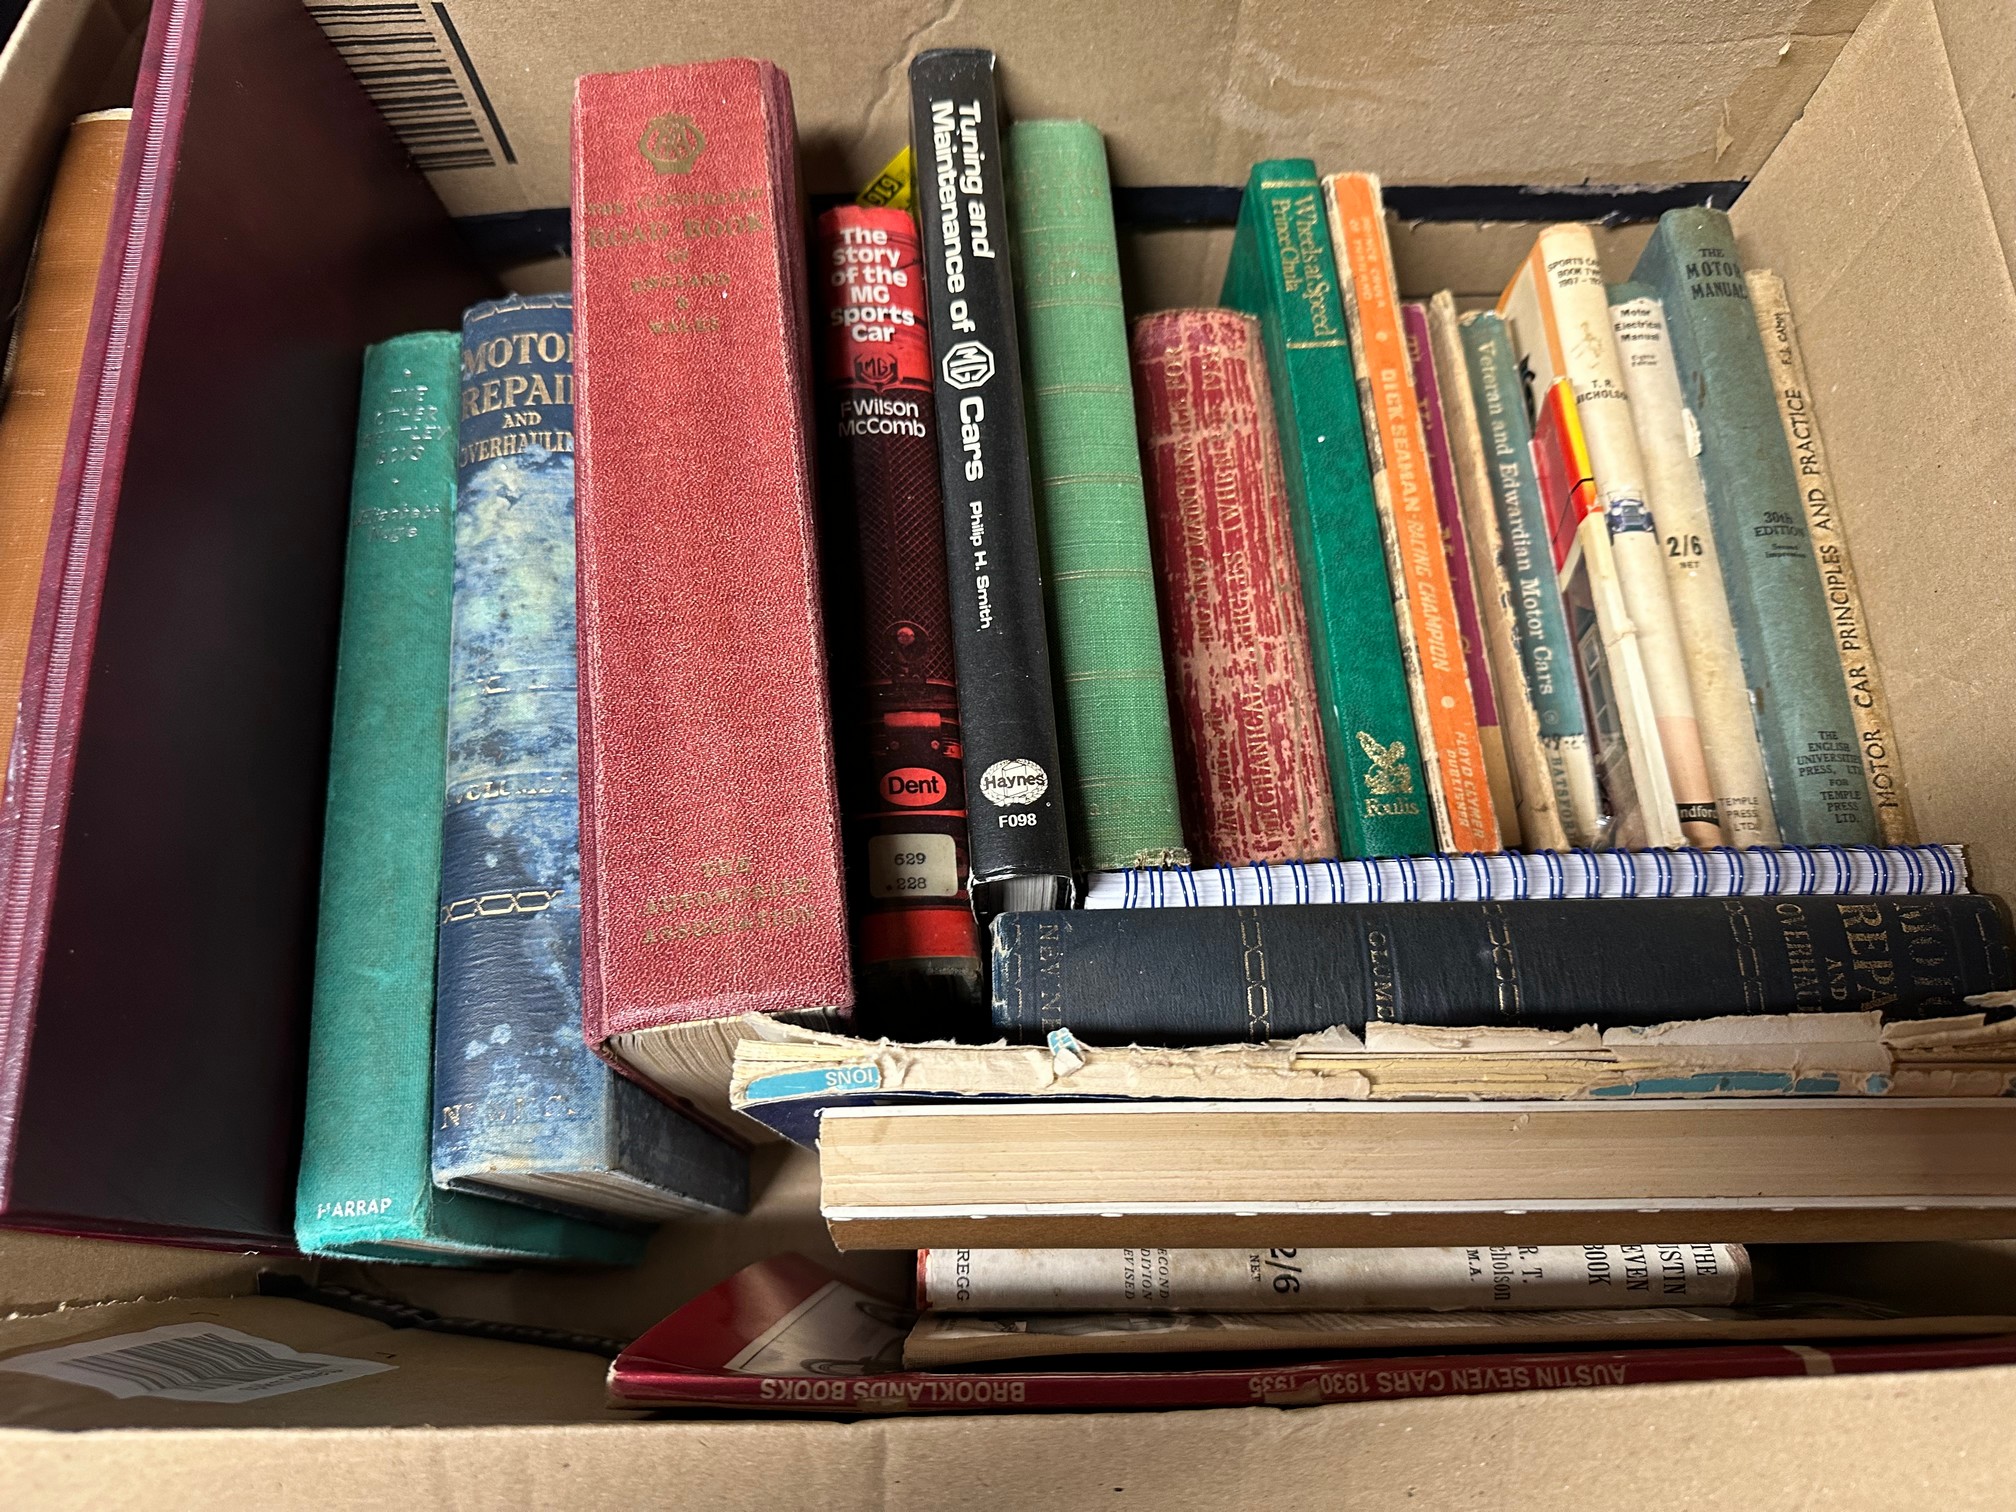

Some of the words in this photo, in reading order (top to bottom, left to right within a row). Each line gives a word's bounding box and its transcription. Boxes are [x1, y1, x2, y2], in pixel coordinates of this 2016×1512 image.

[959, 100, 985, 194] Tuning
[931, 100, 965, 293] Maintenance
[588, 221, 670, 249] ROAD
[684, 212, 765, 239] BOOK
[840, 227, 888, 245] The
[967, 201, 995, 258] and
[1295, 194, 1324, 263] Wheels
[832, 247, 901, 268] story
[1701, 249, 1725, 258] THE
[831, 266, 859, 287] of
[863, 265, 908, 288] the
[1304, 264, 1322, 283] at
[1686, 262, 1742, 280] MOTOR
[630, 272, 731, 294] ENGLAND
[851, 285, 890, 304] MG
[1692, 282, 1748, 300] MANUAL
[830, 304, 915, 327] sports
[950, 300, 976, 333] of
[1302, 281, 1337, 338] Speed
[1620, 308, 1651, 318] Motor
[649, 318, 720, 336] WALES
[851, 323, 895, 343] Car
[1614, 321, 1662, 332] Electrical
[1620, 332, 1661, 342] Manual
[865, 357, 889, 377] MG
[947, 343, 991, 387] MG
[1478, 340, 1504, 416] Veteran
[462, 374, 573, 421] REPAI
[1381, 369, 1404, 420] DICK
[854, 398, 919, 418] Wilson
[502, 411, 542, 429] AND
[838, 417, 926, 438] McComb
[960, 396, 985, 482] Cars
[1491, 420, 1515, 457] and
[1785, 389, 1820, 475] PRACTICE
[1391, 424, 1420, 512] SEAMAN
[1499, 462, 1533, 572] Edwardian
[1764, 511, 1793, 525] 30th
[1808, 488, 1833, 531] AND
[969, 500, 985, 547] Philip
[1754, 525, 1806, 538] EDITION
[1406, 520, 1432, 577] RACING
[1667, 534, 1703, 557] 2/6
[974, 550, 988, 571] H.
[1679, 561, 1701, 569] NET
[976, 575, 993, 629] Smith
[1519, 578, 1546, 640] Motor
[1820, 544, 1861, 651] PRINCIPLES
[1418, 581, 1450, 672] CHAMPION
[1533, 646, 1555, 695] Cars
[1850, 666, 1873, 709] CAR
[1818, 731, 1838, 740] THE
[1456, 731, 1473, 777] FLOYD
[1808, 743, 1850, 752] ENGLISH
[1864, 728, 1898, 809] MOTOR
[888, 776, 939, 795] Dent
[985, 773, 1045, 790] Haynes
[1718, 797, 1759, 806] TEMPLE
[1820, 791, 1861, 800] TEMPLE
[1827, 802, 1858, 812] PRESS
[1363, 797, 1421, 819] Foulis
[1727, 809, 1759, 819] PRESS
[999, 813, 1037, 828] F098
[894, 852, 926, 866] 629
[1836, 903, 1899, 1012] REPA
[1825, 957, 1848, 1000] AND
[825, 1067, 876, 1087] IONS
[957, 1248, 970, 1302] REGG
[1123, 1248, 1136, 1300] EVISED
[1140, 1248, 1153, 1301] DITION
[1156, 1248, 1170, 1300] ECOND
[1249, 1254, 1262, 1282] NET
[1264, 1248, 1302, 1295] 2/6
[1489, 1246, 1515, 1300] cholson
[1522, 1267, 1543, 1283] T.
[1620, 1245, 1649, 1291] EVEN
[1319, 1373, 1369, 1395] 1930
[1376, 1371, 1445, 1394] CARS
[1452, 1367, 1531, 1390] SEVEN
[1535, 1363, 1627, 1387] AUSTIN
[760, 1378, 846, 1400] BOOKS
[853, 1381, 1026, 1402] BROOKLANDS
